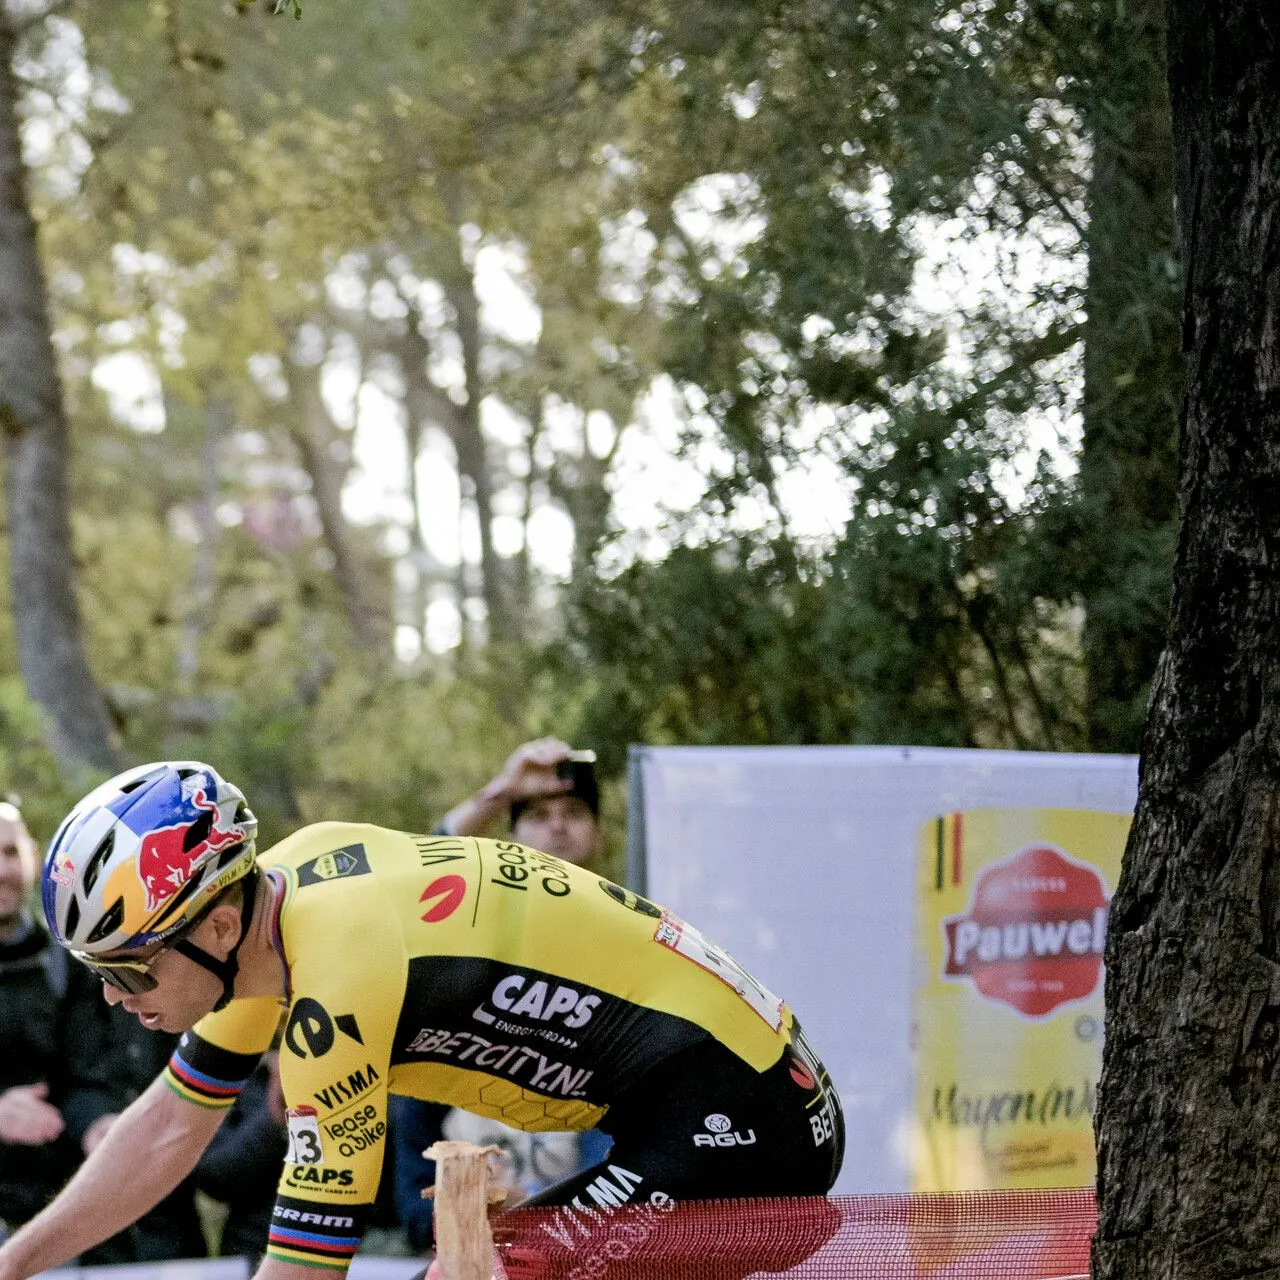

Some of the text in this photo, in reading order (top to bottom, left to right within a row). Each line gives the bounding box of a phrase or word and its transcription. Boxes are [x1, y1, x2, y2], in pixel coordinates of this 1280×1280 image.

[413, 836, 466, 866] VIS
[491, 842, 528, 891] leas
[953, 906, 1108, 966] Pauwel
[492, 974, 602, 1029] CAPS
[494, 1019, 559, 1041] ENERGY CARD
[313, 1063, 380, 1110] VISMA
[324, 1104, 377, 1141] lease
[693, 1128, 757, 1148] AGU
[292, 1165, 354, 1187] CAPS
[272, 1205, 354, 1229] SRAM
[540, 1164, 643, 1251] VISMA
